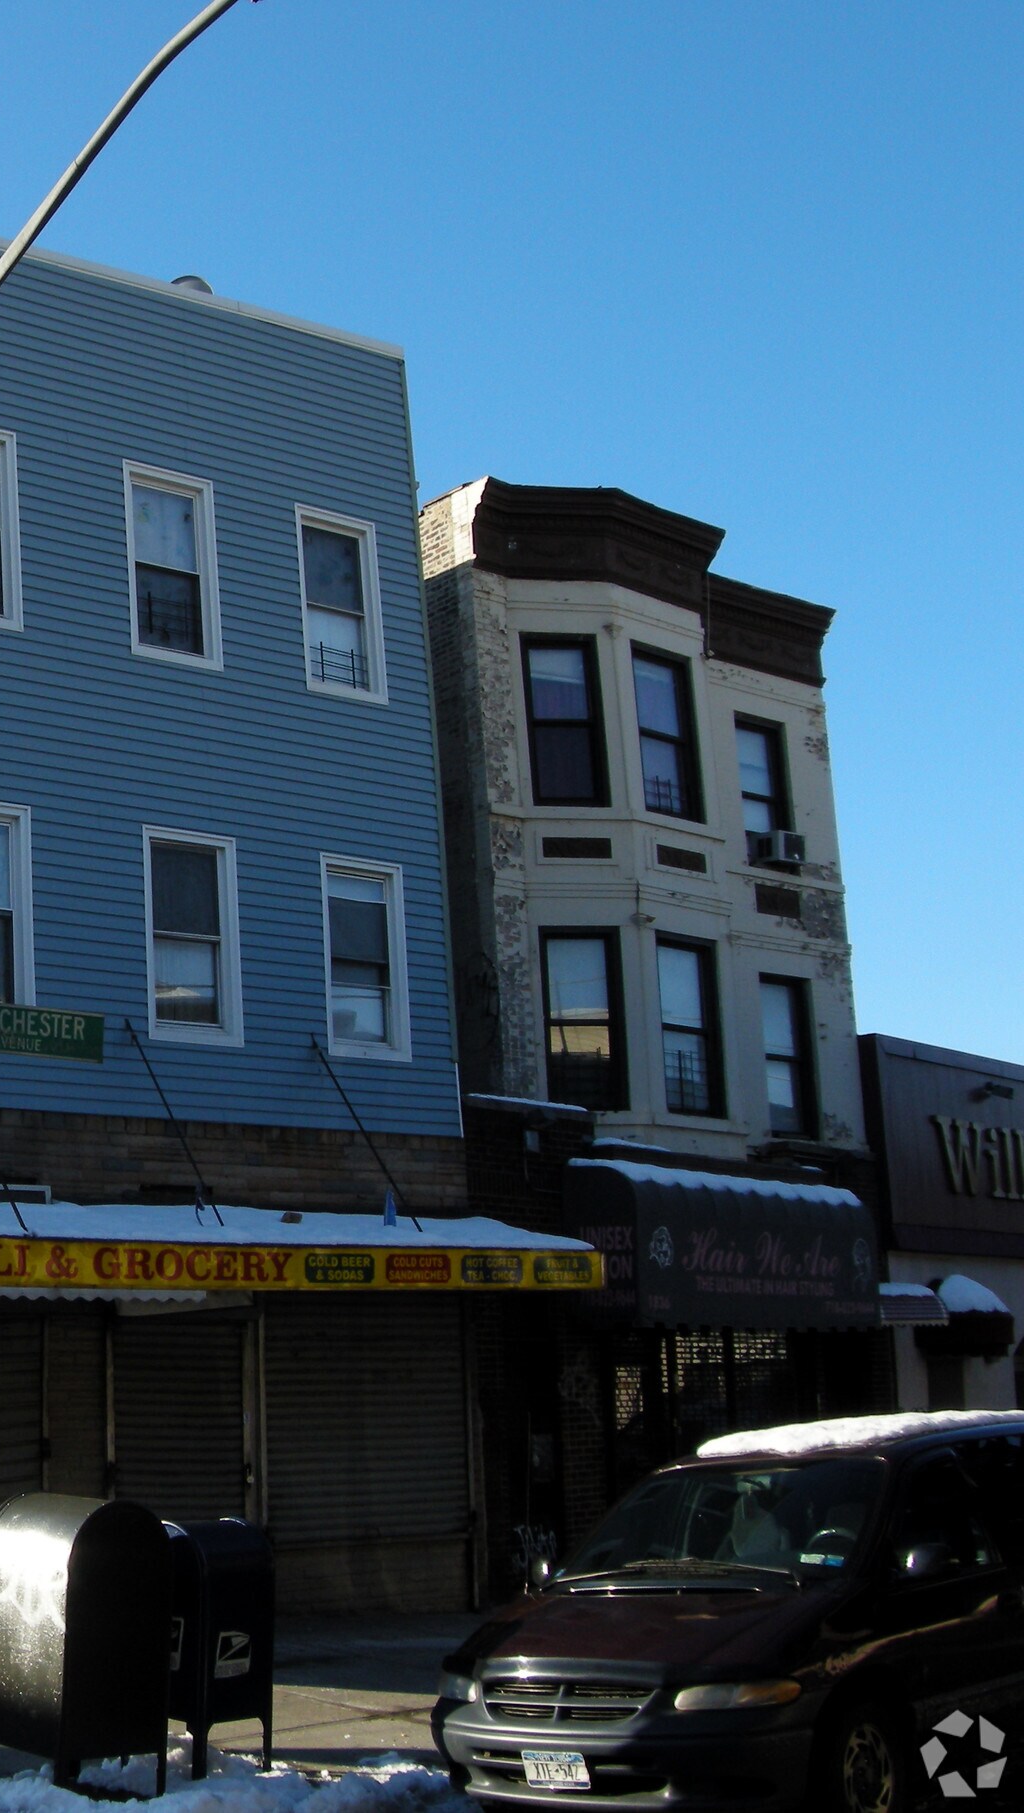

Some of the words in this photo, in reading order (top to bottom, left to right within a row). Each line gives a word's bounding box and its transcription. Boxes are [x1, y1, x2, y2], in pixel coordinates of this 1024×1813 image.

[580, 1226, 633, 1251] UNISEX
[682, 1226, 747, 1272] Hair
[755, 1232, 791, 1276] We
[795, 1235, 842, 1278] Are
[46, 1246, 79, 1280] &
[93, 1247, 293, 1282] GROCERY
[308, 1256, 338, 1268] COLD
[341, 1256, 371, 1268] BEER
[393, 1258, 417, 1269] COLD
[419, 1258, 444, 1269] CUTS
[466, 1258, 484, 1269] HOT
[486, 1258, 519, 1269] COFFEE
[546, 1259, 570, 1270] FRUIT
[316, 1270, 323, 1281] &
[328, 1270, 364, 1281] SODAS
[389, 1270, 449, 1281] SANDWICHES
[467, 1270, 485, 1281] TEA
[538, 1270, 590, 1281] VEGETABLES
[696, 1275, 714, 1292] THE
[716, 1276, 761, 1294] ULTIMATE
[763, 1279, 774, 1295] IN
[776, 1280, 797, 1296] HAIR
[799, 1280, 835, 1297] STYLING
